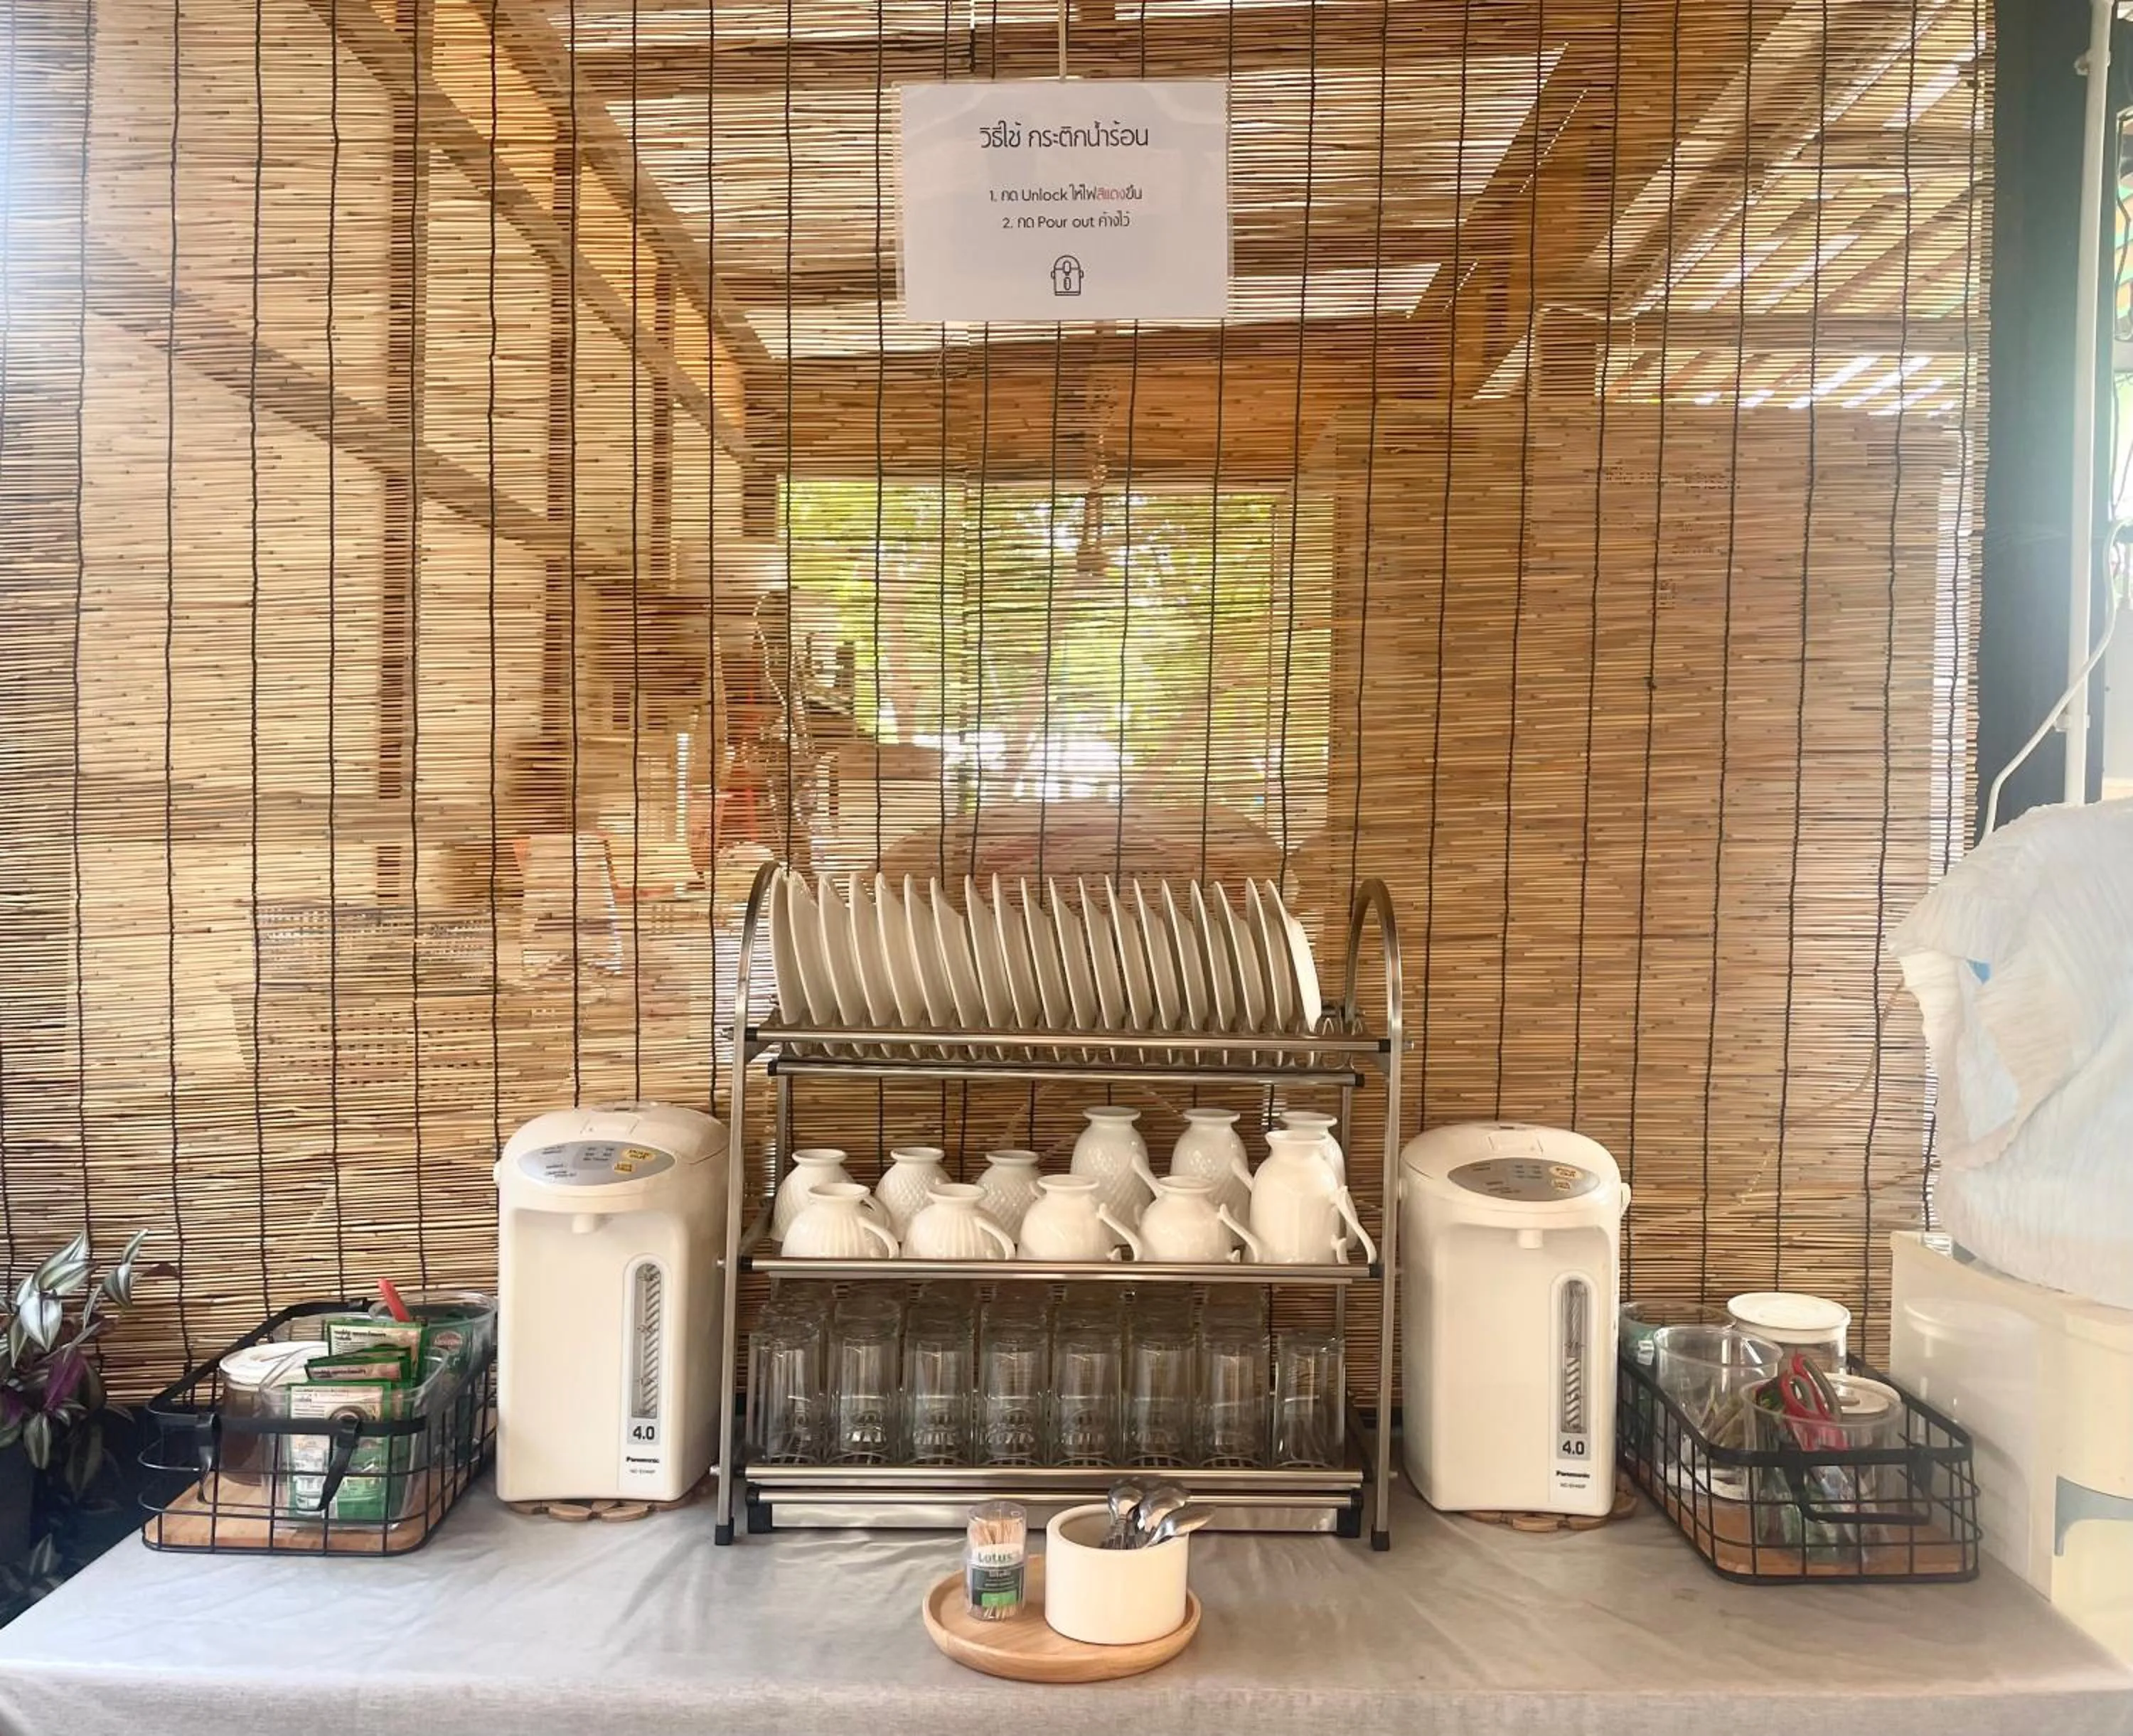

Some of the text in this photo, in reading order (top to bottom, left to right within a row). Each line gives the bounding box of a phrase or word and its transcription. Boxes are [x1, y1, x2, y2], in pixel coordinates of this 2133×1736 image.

[979, 119, 1148, 148] วิธีใช้ กระติกน้ำร้อน
[989, 190, 998, 202] 1.
[1001, 190, 1018, 201] กด
[1022, 188, 1069, 201] Unlock
[1003, 210, 1130, 228] 2. กด Pour out ค้างไว้
[632, 1425, 655, 1440] 4.0
[1562, 1440, 1585, 1455] 4.0
